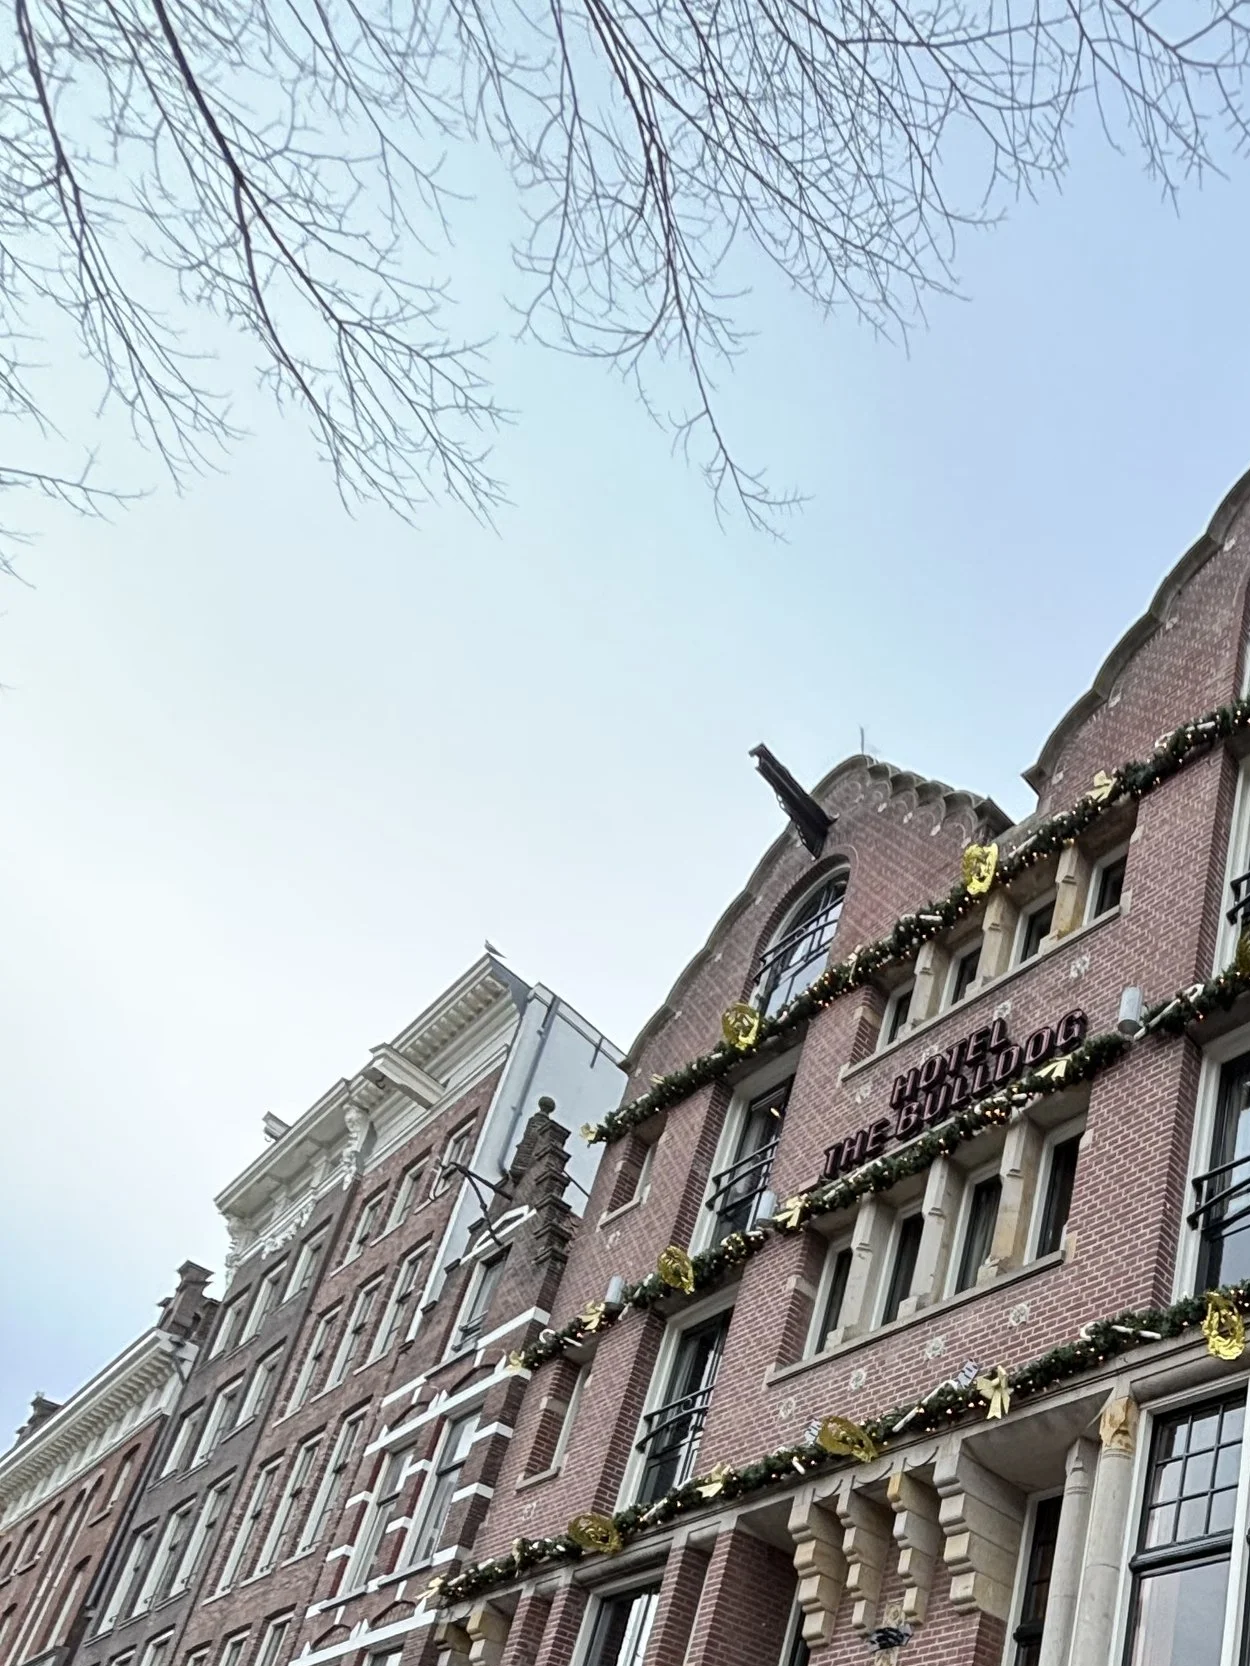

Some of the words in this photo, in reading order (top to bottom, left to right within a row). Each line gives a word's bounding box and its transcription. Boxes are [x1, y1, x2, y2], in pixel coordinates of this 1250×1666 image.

[824, 1117, 890, 1180] THE
[894, 1007, 1088, 1141] BULLDOG
[890, 1016, 1012, 1110] HOTEL
